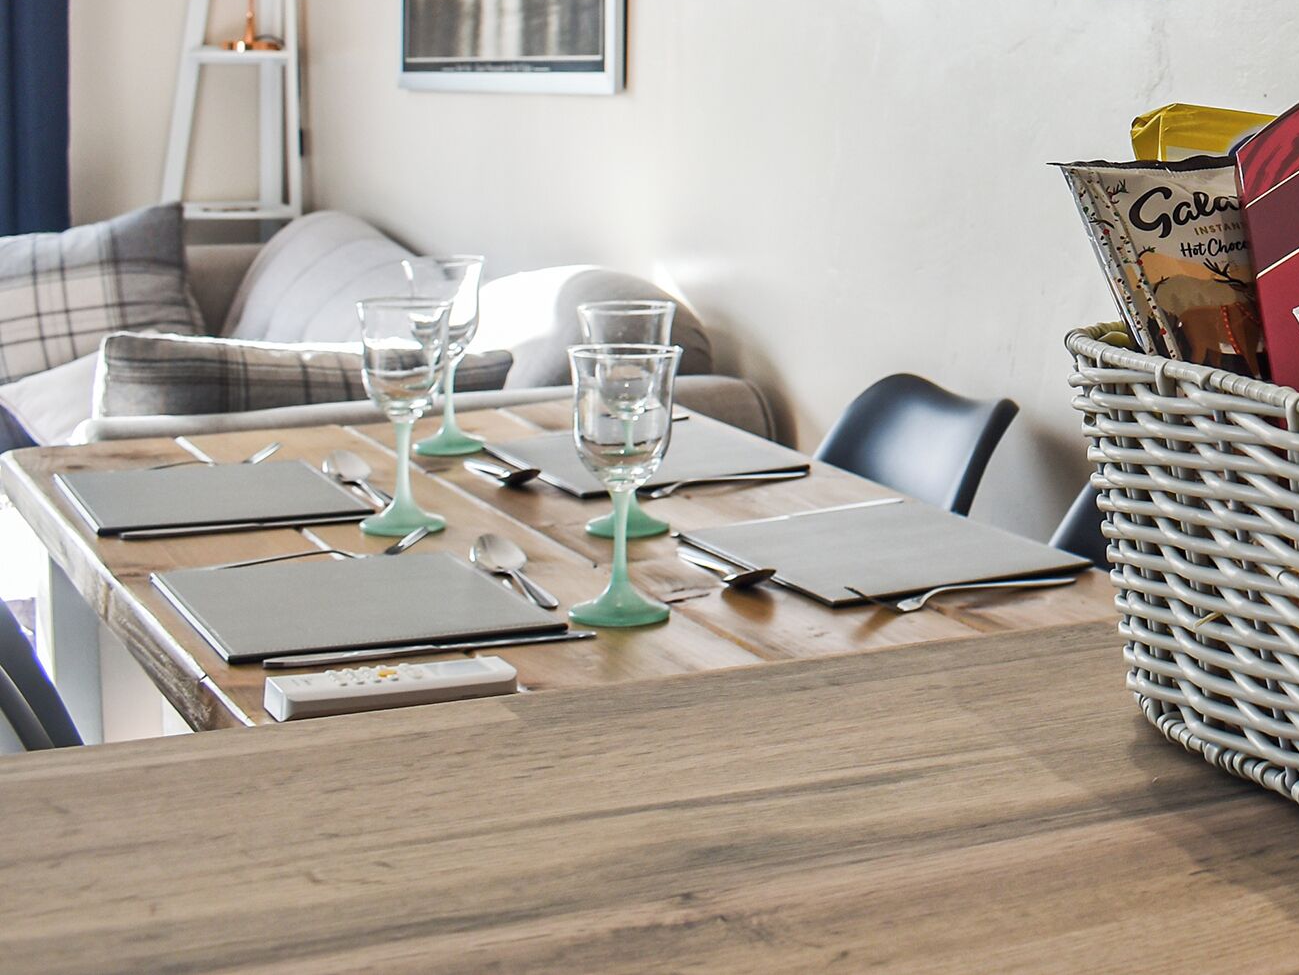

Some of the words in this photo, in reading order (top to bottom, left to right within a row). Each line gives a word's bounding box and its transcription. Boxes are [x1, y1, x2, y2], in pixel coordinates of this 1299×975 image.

[1129, 186, 1242, 238] Gala
[1194, 222, 1245, 236] INSTAN
[1180, 242, 1206, 258] Hot
